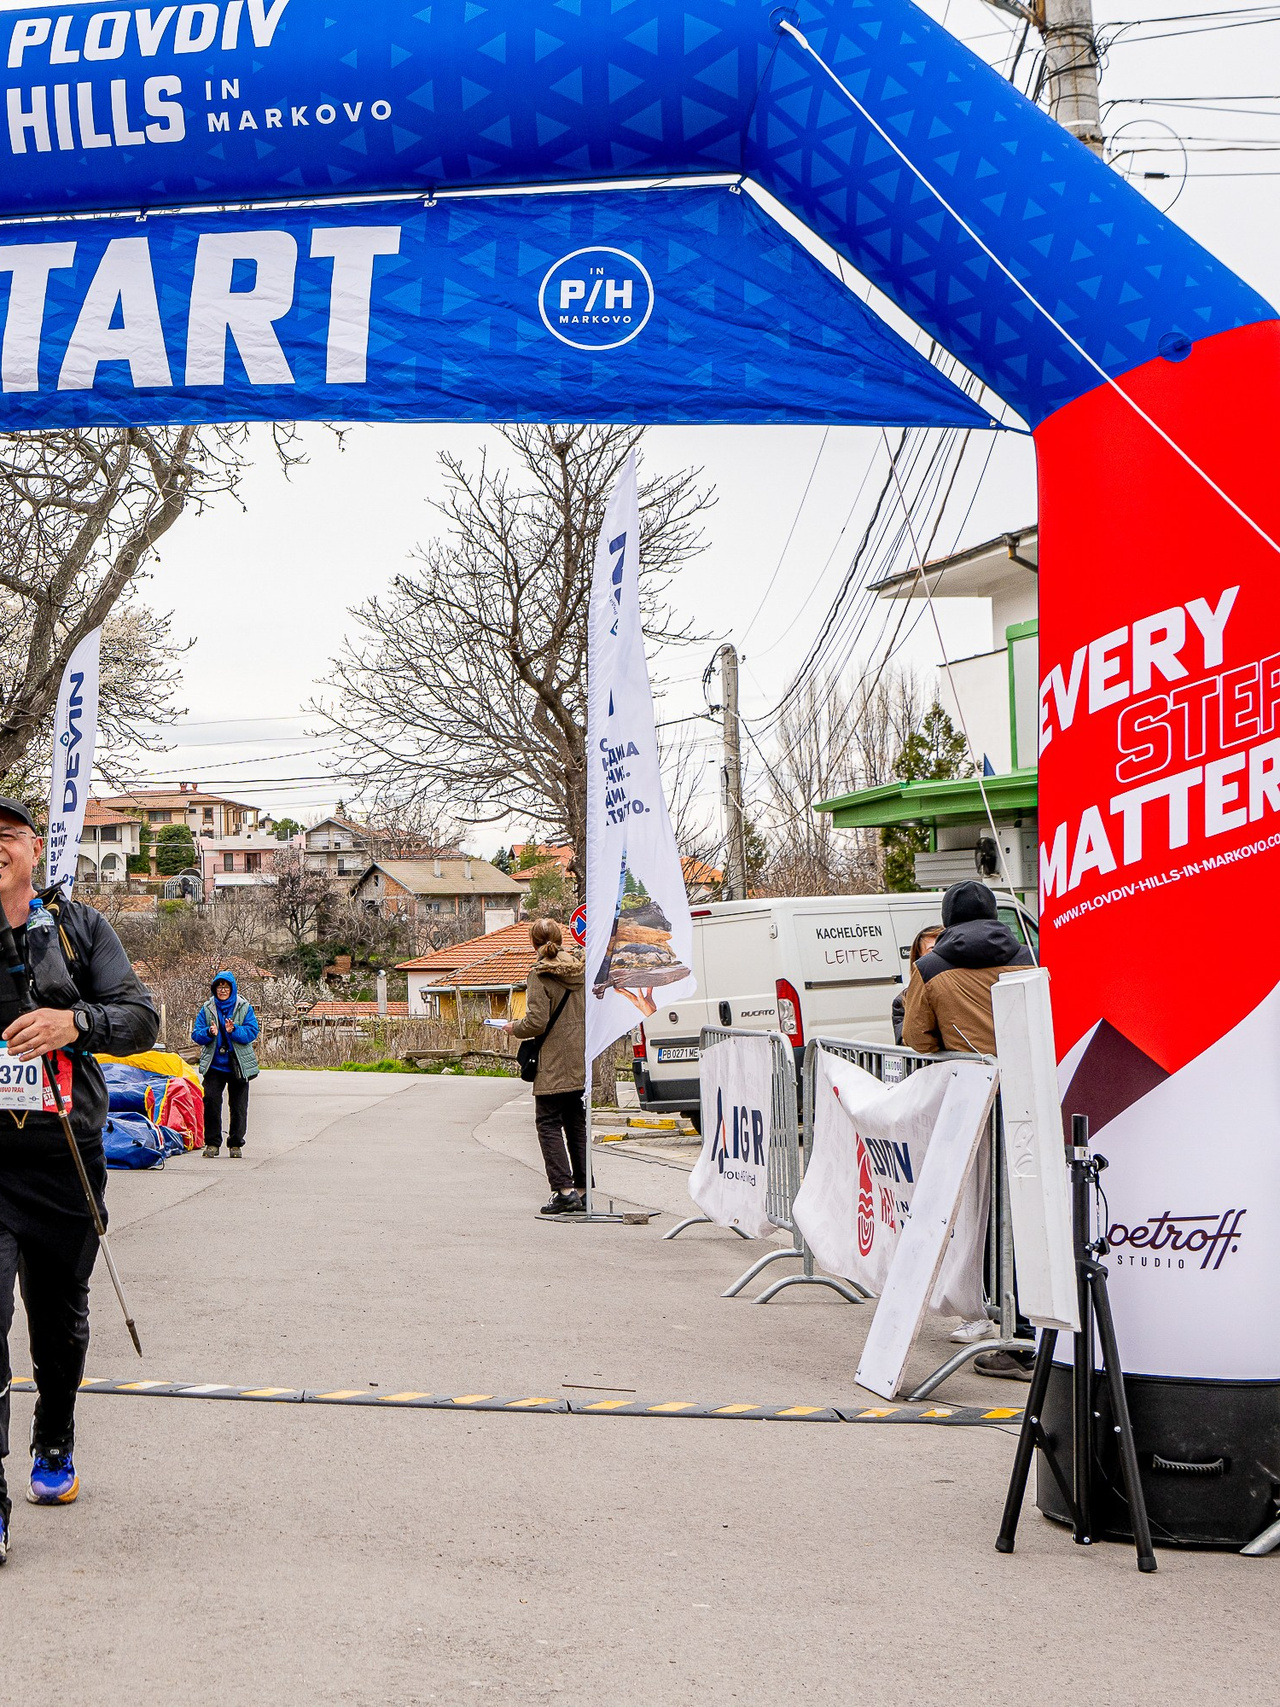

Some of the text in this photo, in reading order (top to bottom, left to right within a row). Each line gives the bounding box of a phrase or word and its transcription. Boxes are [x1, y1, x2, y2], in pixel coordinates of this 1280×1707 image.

[7, 0, 290, 68] PLOVDIV
[204, 78, 241, 101] IN
[5, 75, 186, 154] HILLS
[206, 99, 393, 133] MARKOVO
[589, 267, 605, 276] IN
[559, 315, 632, 324] MARKOVO
[1039, 585, 1240, 758] EVERY
[62, 671, 85, 813] DEVIN
[824, 948, 883, 965] LEITER
[740, 1009, 776, 1018] DUCATO
[1116, 1253, 1185, 1270] STUDIO
